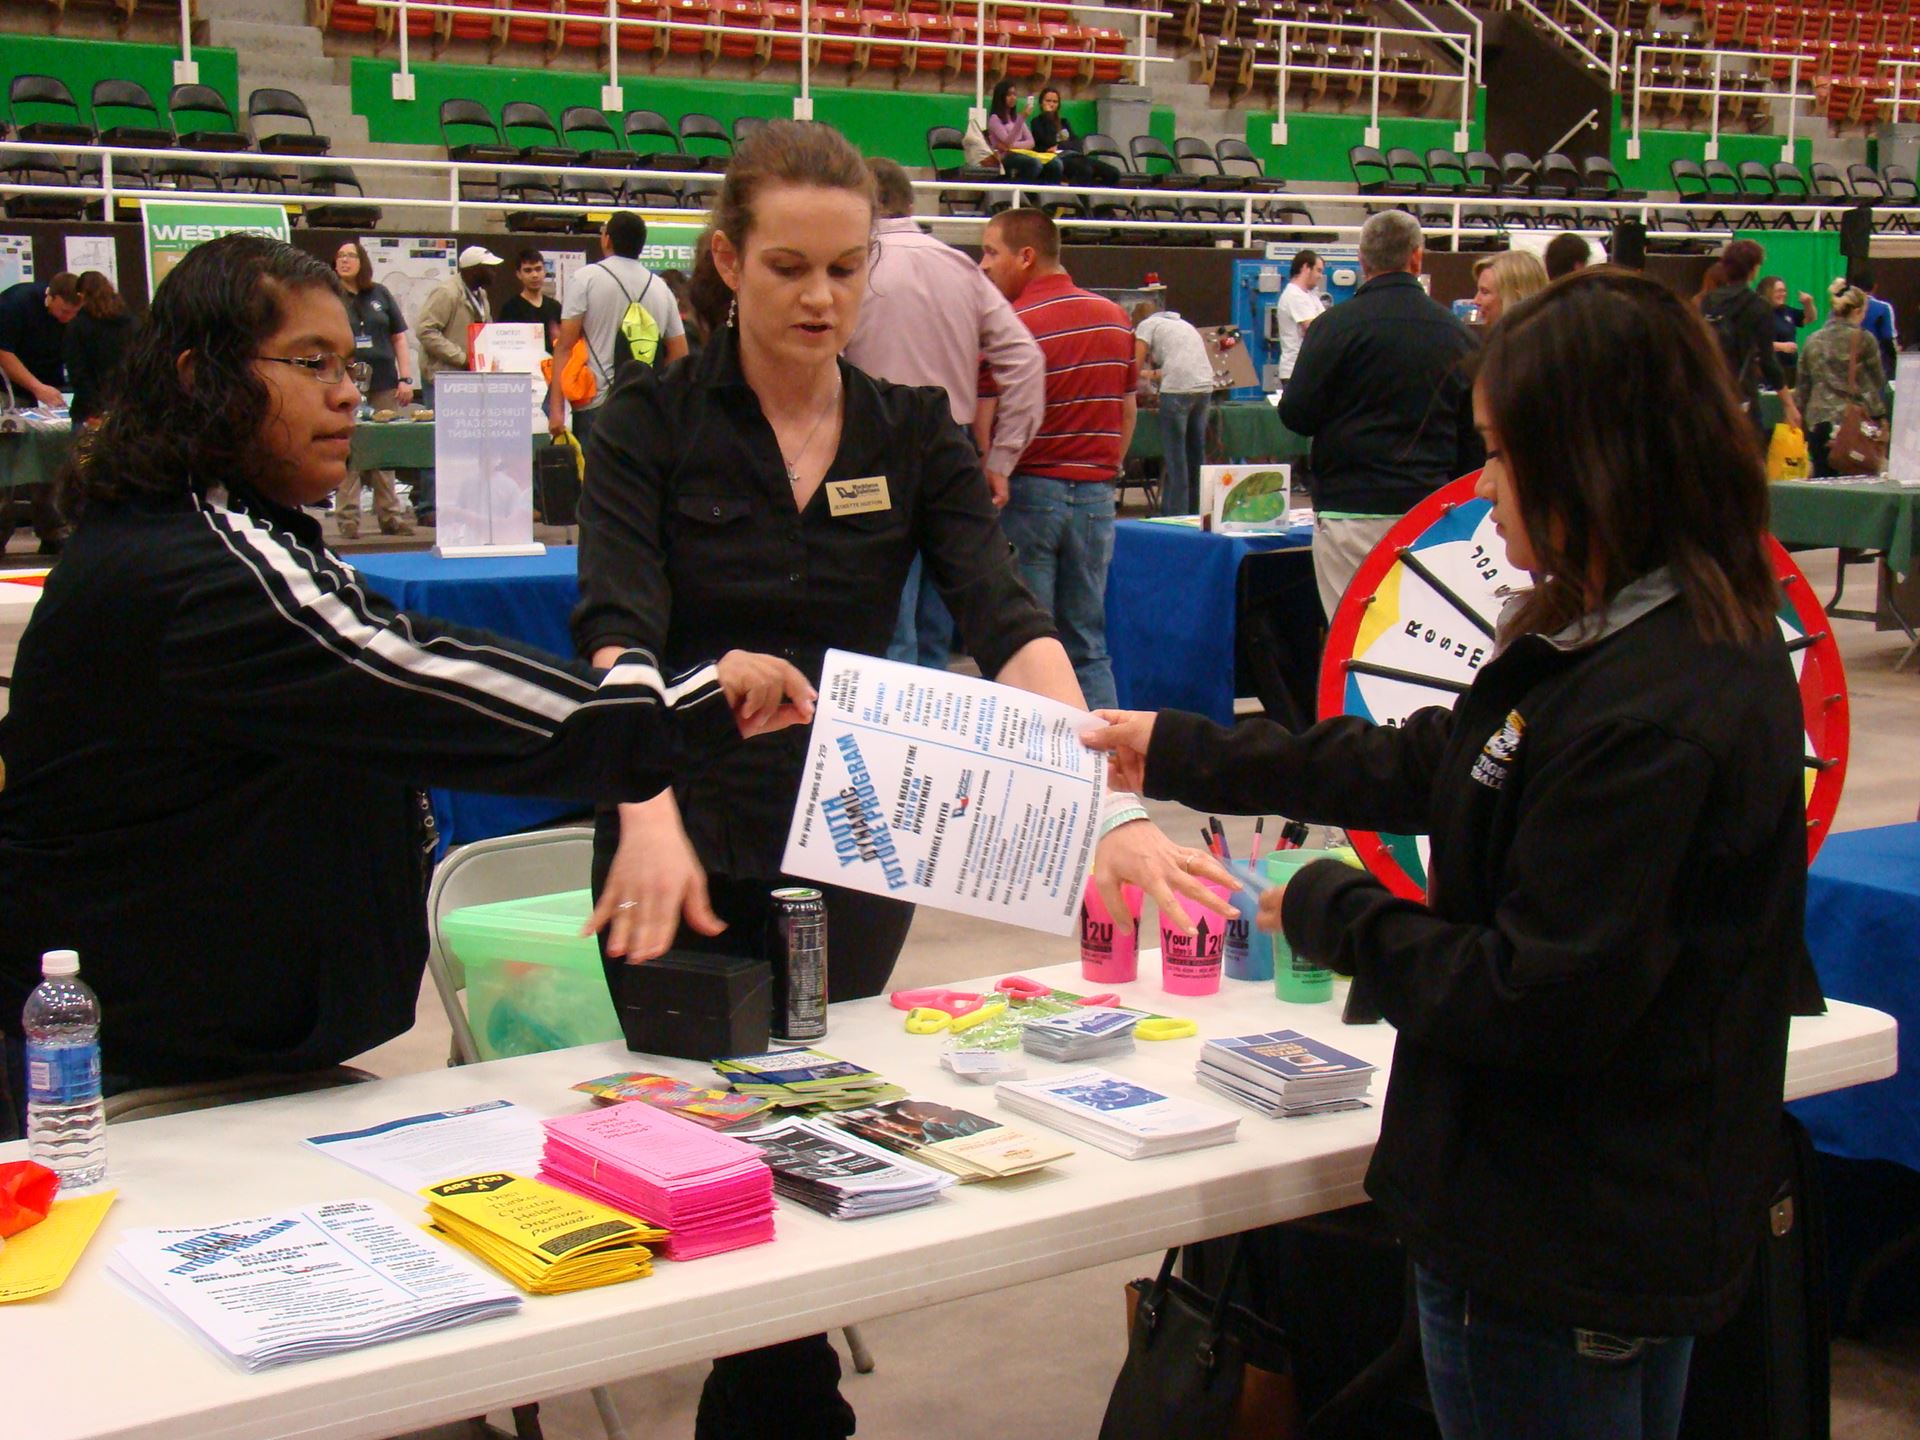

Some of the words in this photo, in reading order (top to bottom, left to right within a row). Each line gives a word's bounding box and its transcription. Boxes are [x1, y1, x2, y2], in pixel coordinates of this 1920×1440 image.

[638, 244, 697, 260] ESTE
[1405, 619, 1485, 669] Resum
[904, 743, 917, 765] TIME
[835, 733, 883, 820] PROGRAM
[902, 766, 913, 777] OF
[897, 777, 910, 801] HEAD
[911, 777, 921, 790] AN
[895, 800, 905, 808] A
[908, 790, 918, 802] UP
[912, 774, 933, 835] APPOINTMENT
[891, 809, 903, 829] CALL
[904, 803, 915, 819] SET
[820, 795, 859, 866] YOUTH
[840, 786, 879, 862] DYNAMIC
[901, 819, 912, 831] TO
[923, 835, 942, 888] WORKFORCE
[934, 801, 949, 834] CENTER
[872, 822, 906, 889] FUTURE
[1162, 928, 1193, 955] Your
[442, 1181, 472, 1194] ARE
[472, 1173, 505, 1186] YOU
[476, 1183, 490, 1192] A
[488, 1195, 539, 1211] Thinker
[498, 1199, 555, 1218] Creator
[513, 1206, 563, 1222] Helper
[519, 1209, 585, 1231] Organizer
[531, 1214, 596, 1238] Persuader
[160, 1231, 232, 1255] YOUTH
[168, 1251, 233, 1275] FUTURE
[222, 1219, 301, 1253] PROGRAM
[180, 1233, 248, 1260] DYNAMIC
[242, 1252, 309, 1267] APPOINTMENT
[192, 1270, 255, 1284] WORKFORCE
[256, 1264, 294, 1274] CENTER
